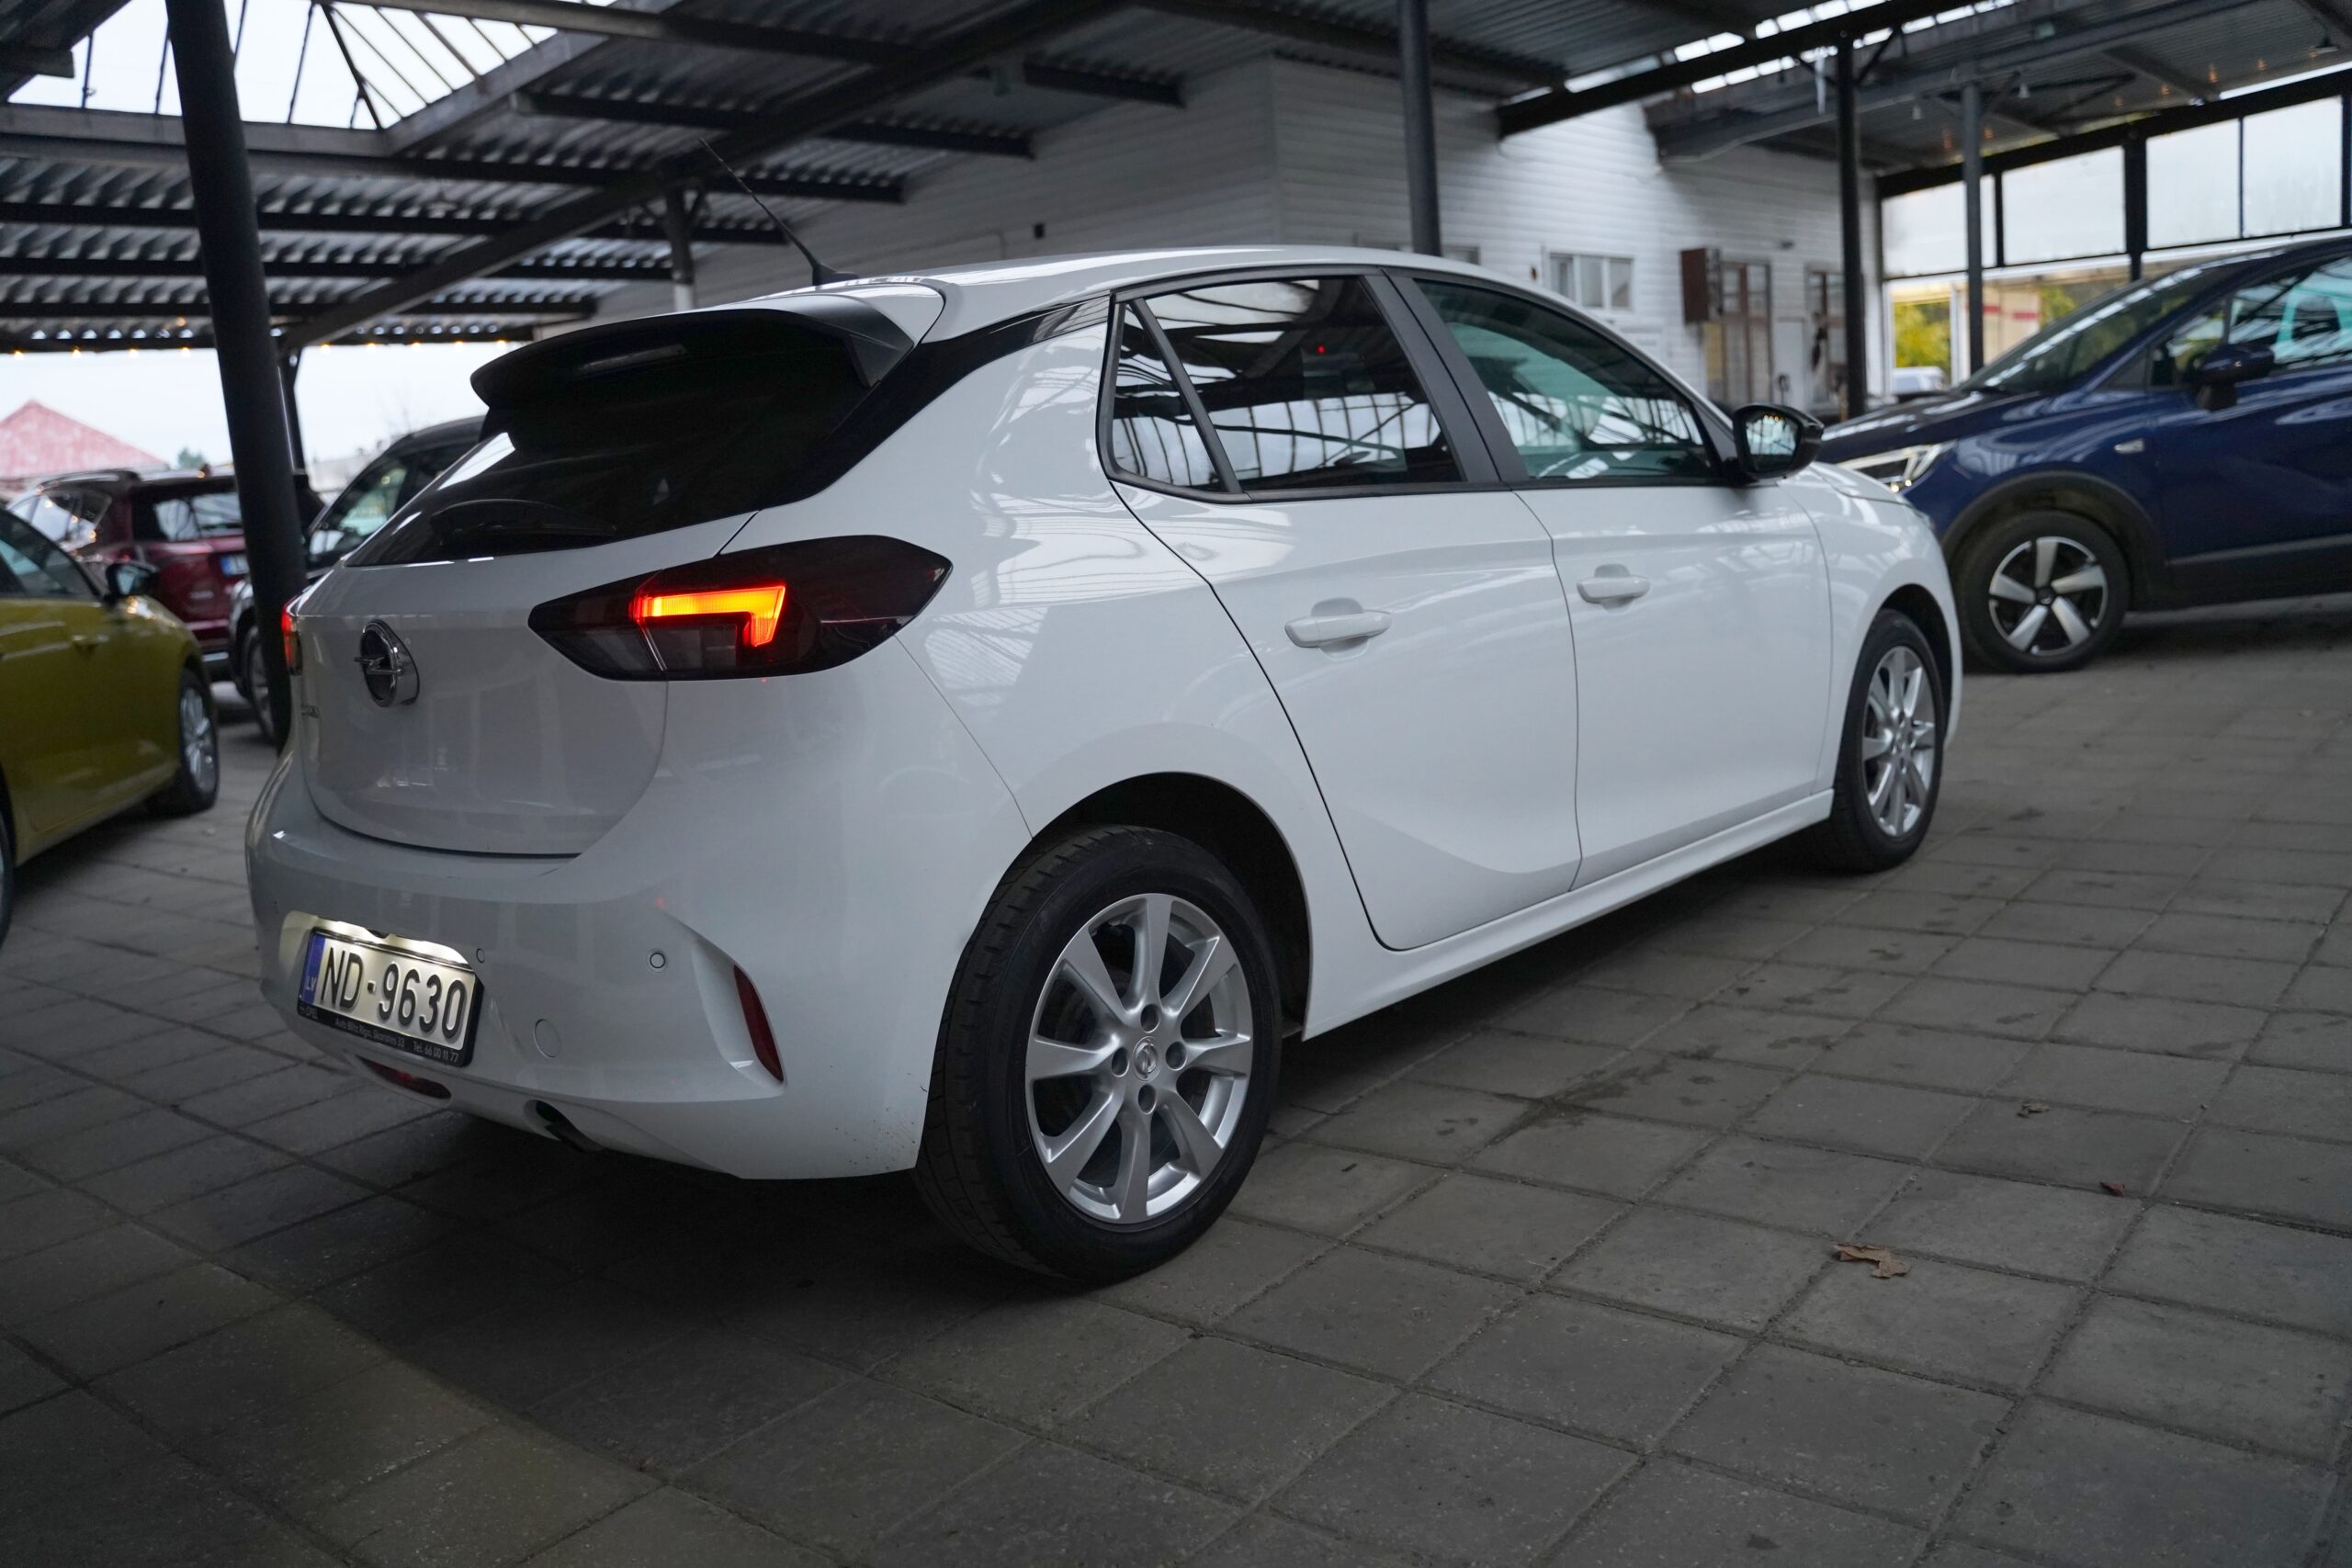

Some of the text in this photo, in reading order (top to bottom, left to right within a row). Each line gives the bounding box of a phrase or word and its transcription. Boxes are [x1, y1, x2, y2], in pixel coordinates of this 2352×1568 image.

[321, 947, 467, 1039] ND-9630
[413, 1041, 459, 1063] Tel. 66 00 11 77
